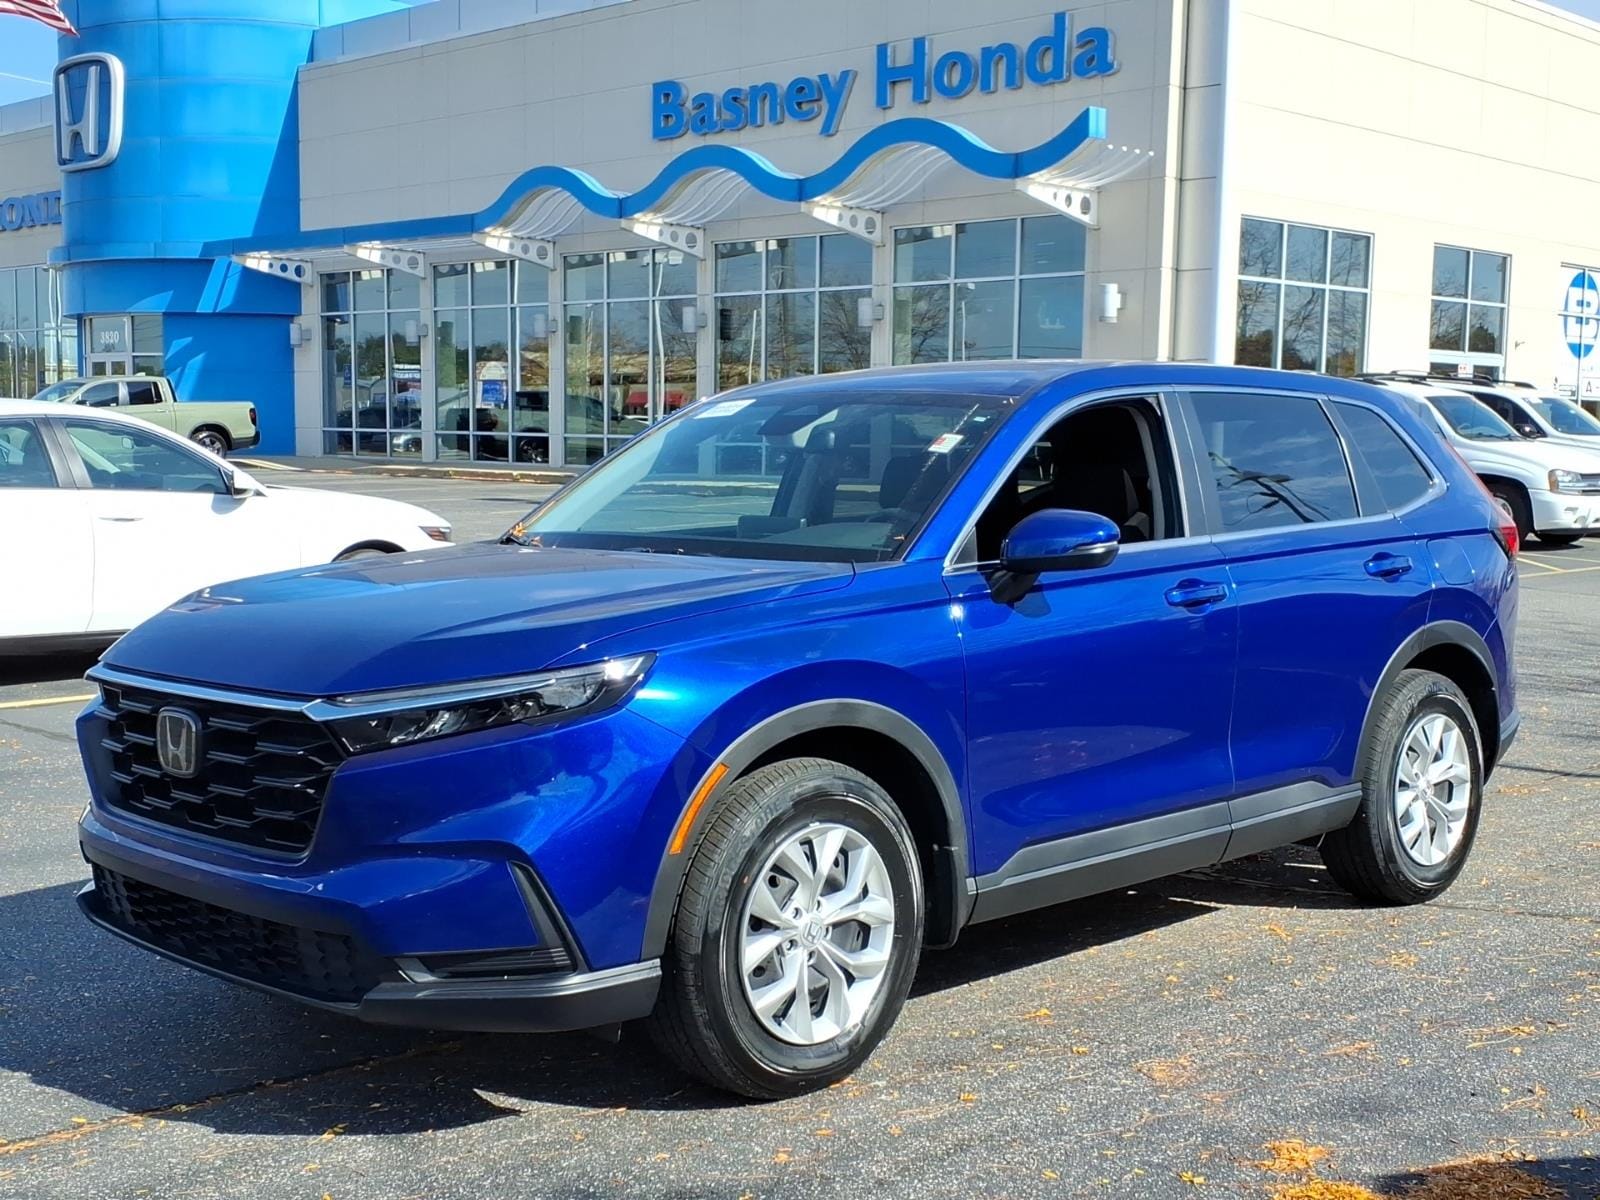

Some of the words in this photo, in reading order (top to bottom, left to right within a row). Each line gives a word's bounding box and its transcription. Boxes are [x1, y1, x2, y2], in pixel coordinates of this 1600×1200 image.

[652, 69, 857, 141] Basney
[876, 11, 1120, 110] Honda
[0, 190, 62, 231] OND
